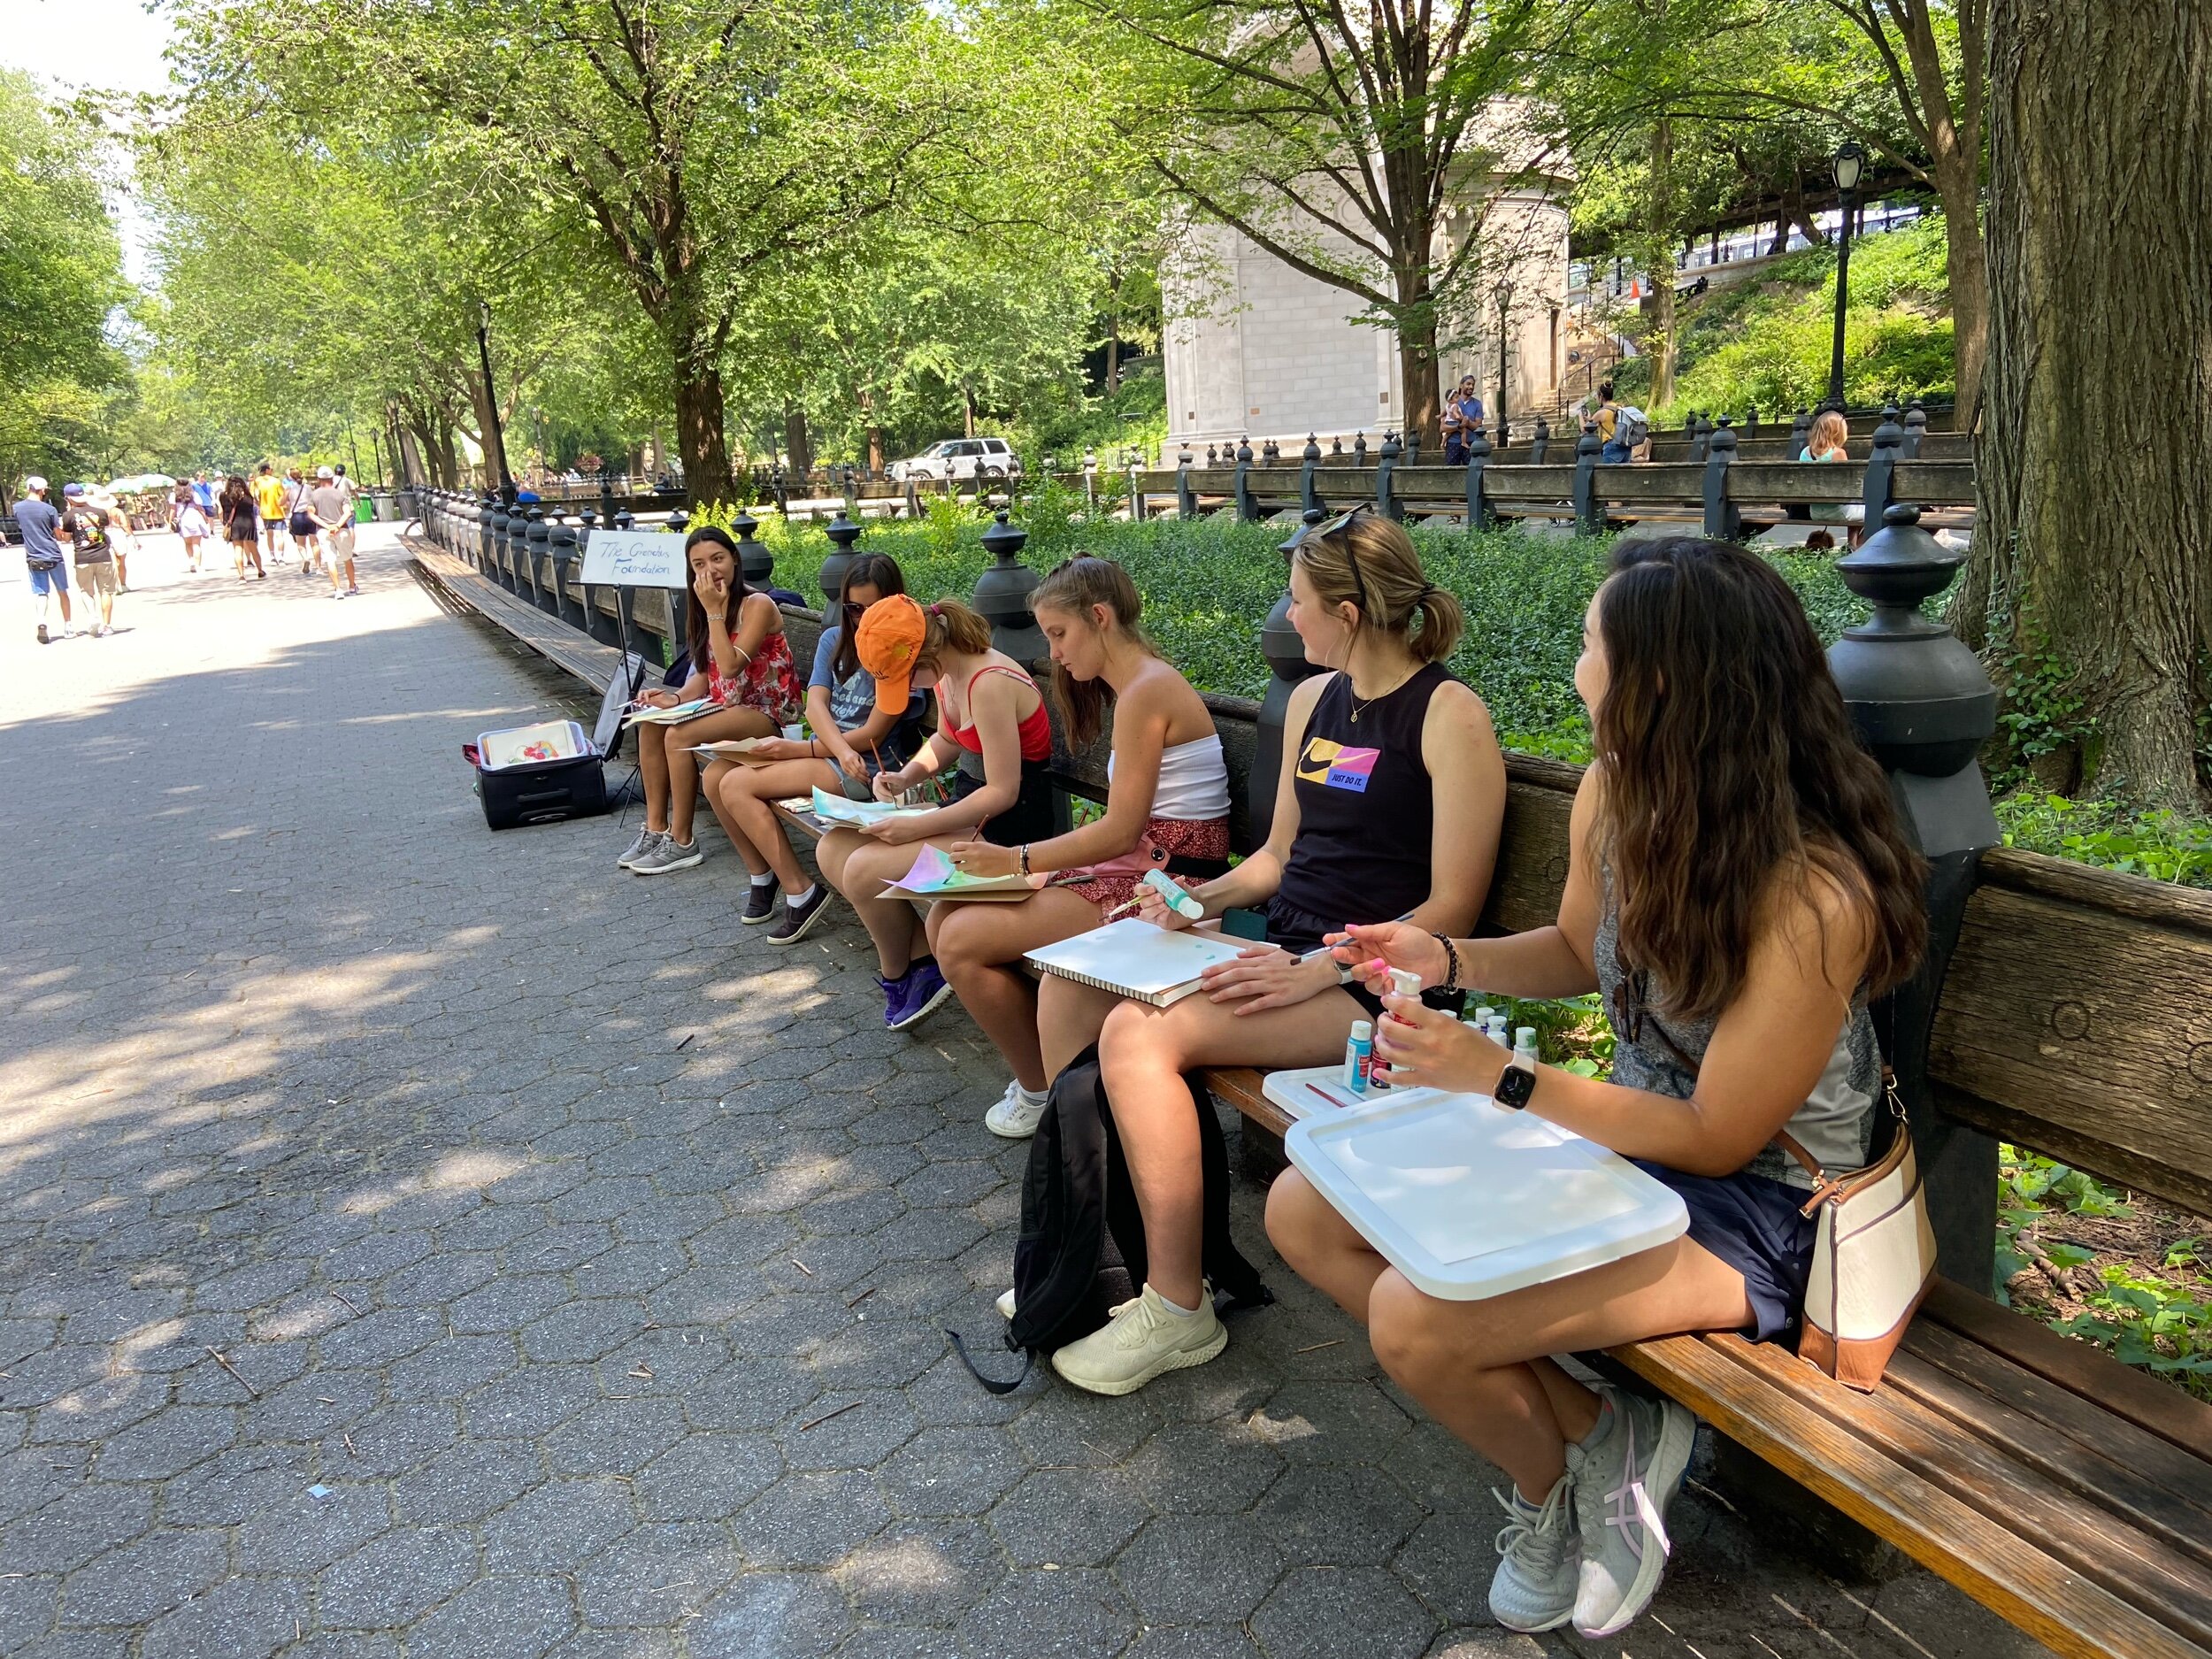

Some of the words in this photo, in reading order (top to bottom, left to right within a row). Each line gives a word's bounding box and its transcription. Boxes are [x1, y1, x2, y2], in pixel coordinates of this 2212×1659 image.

[600, 541, 623, 557] The
[611, 557, 670, 575] Foundation
[1332, 773, 1345, 782] JUST
[1345, 776, 1354, 785] DO
